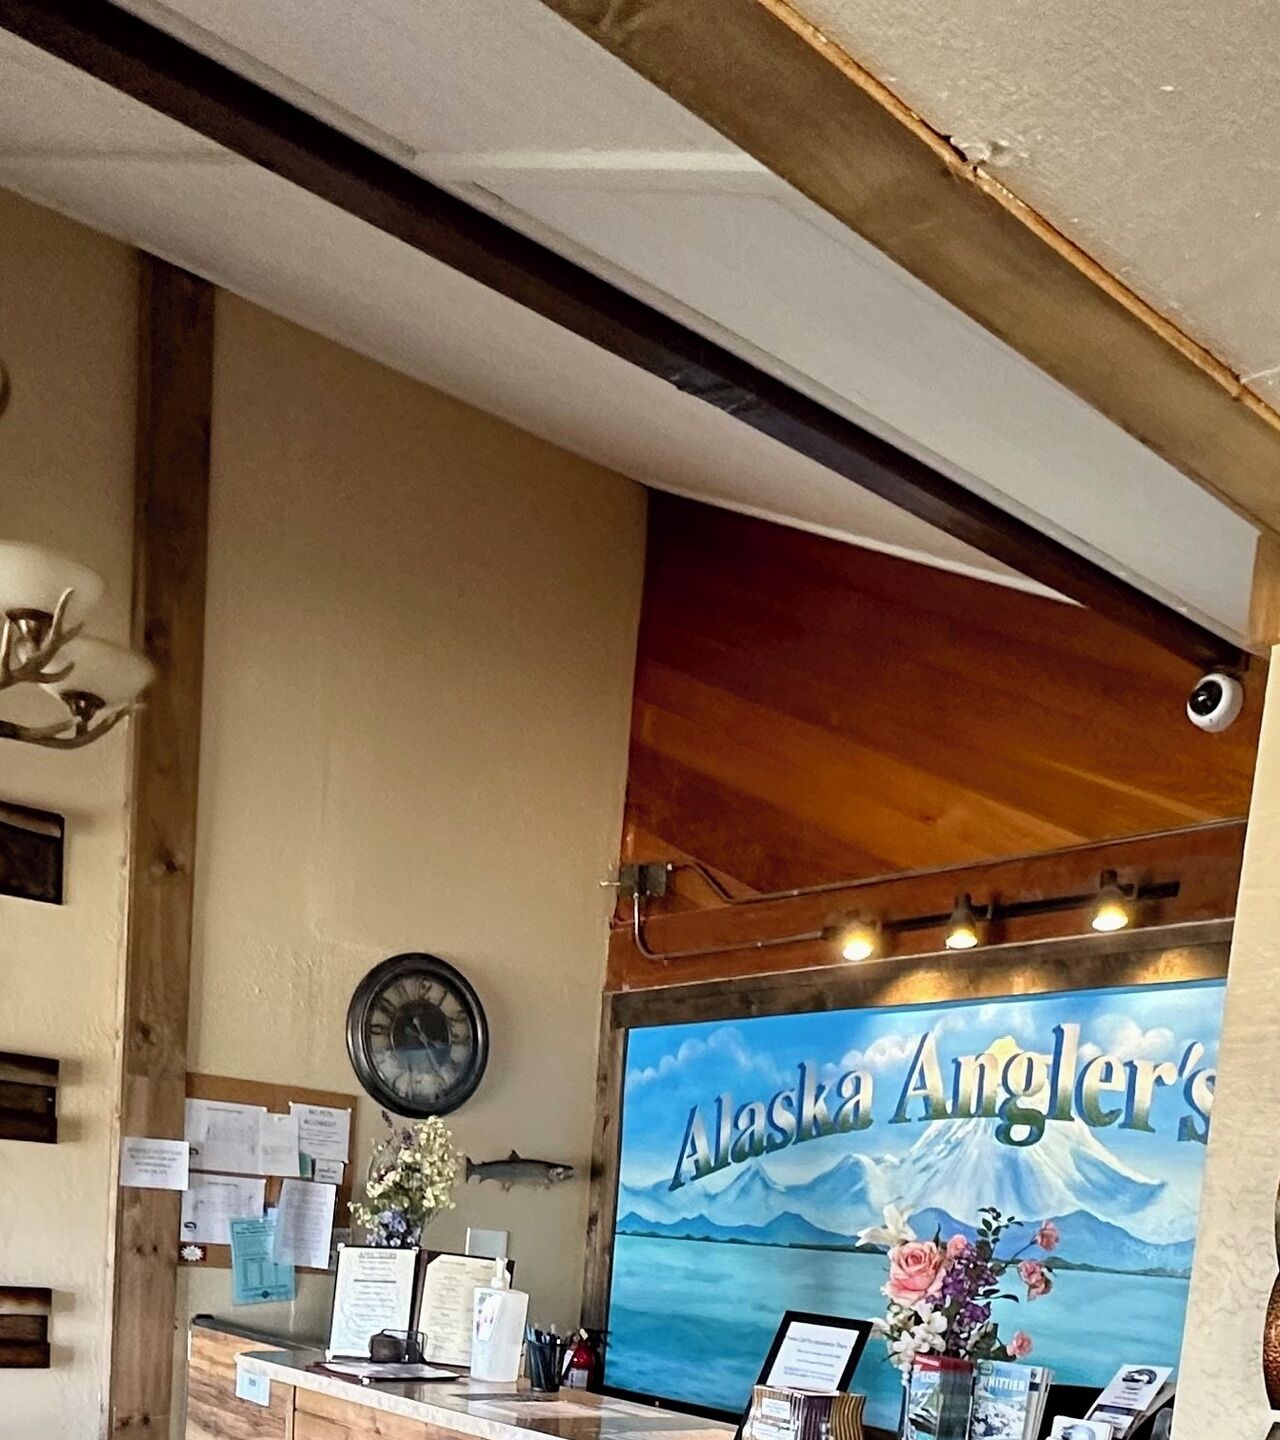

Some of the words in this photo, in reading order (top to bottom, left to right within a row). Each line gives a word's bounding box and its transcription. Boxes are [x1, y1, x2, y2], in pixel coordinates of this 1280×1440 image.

[668, 1061, 874, 1191] Alaska
[888, 1022, 1217, 1146] Angler's
[979, 1375, 1026, 1393] WHITTIER
